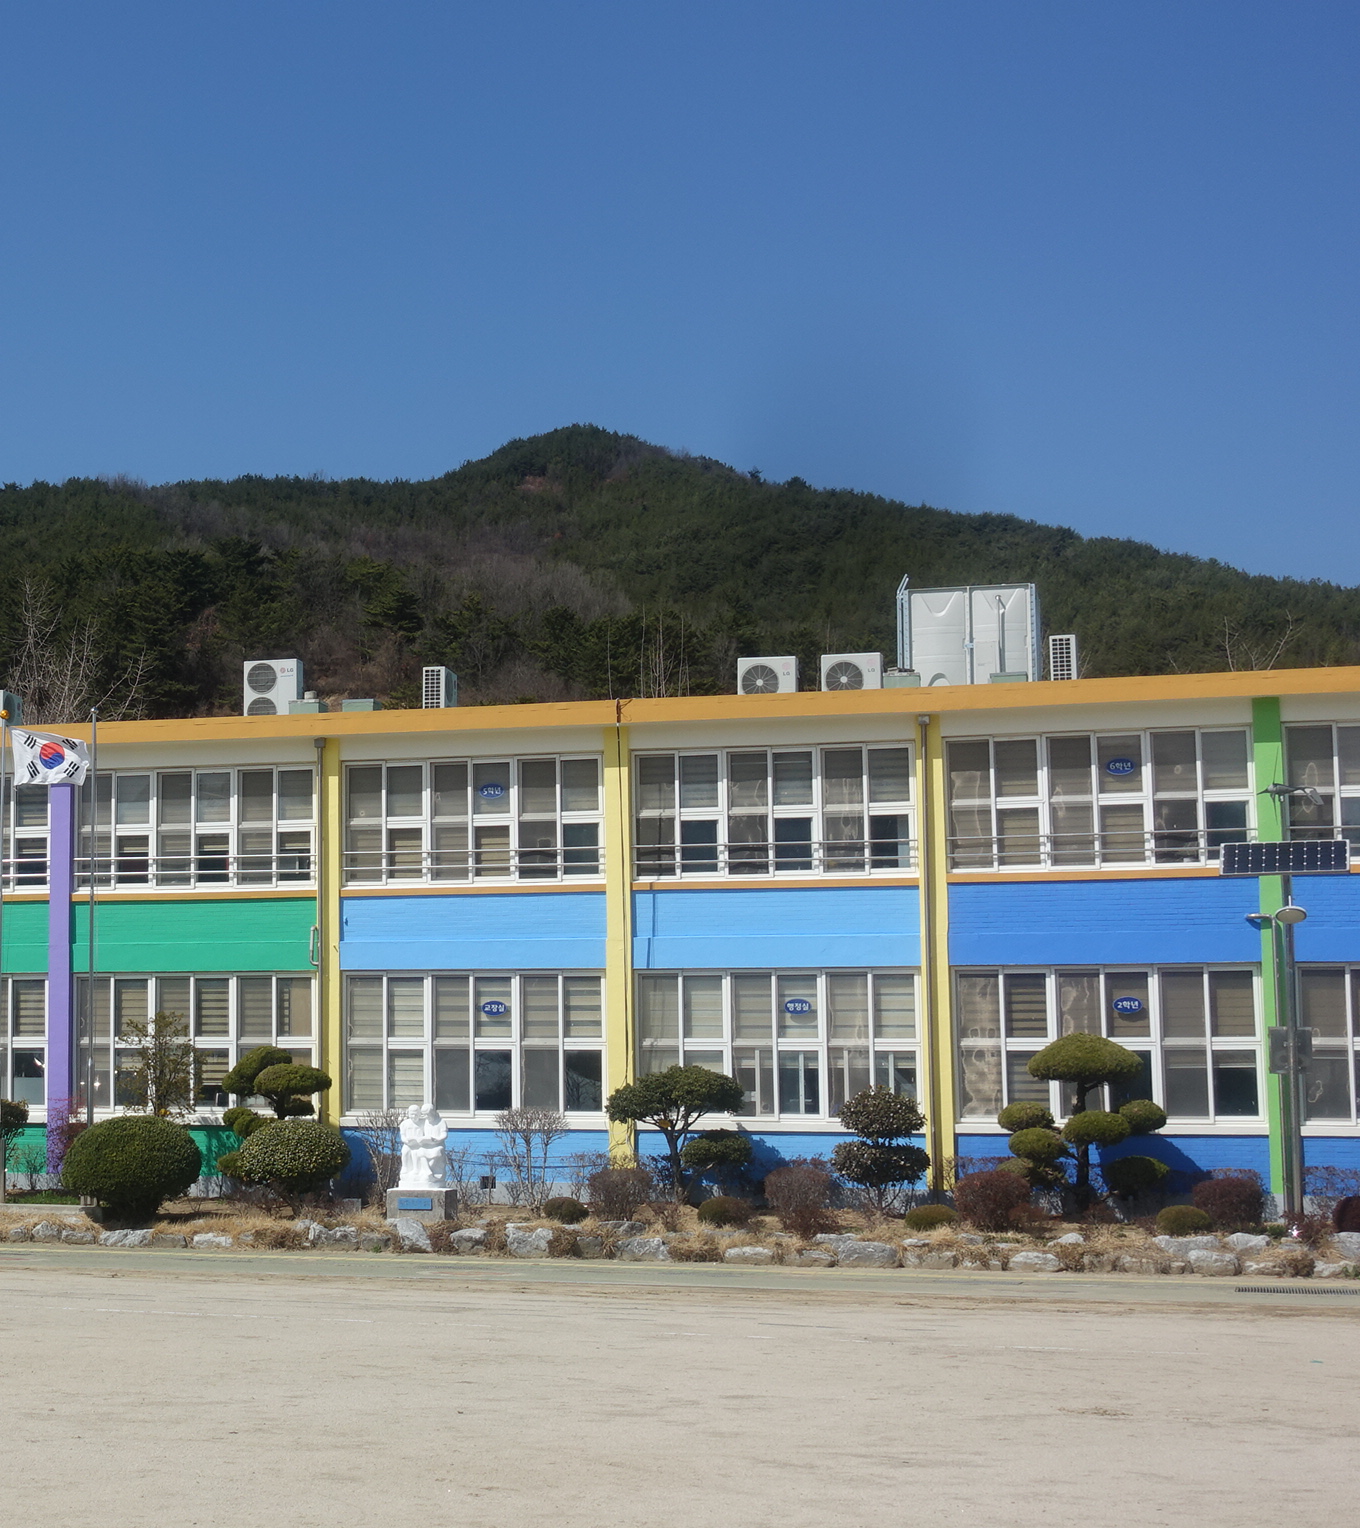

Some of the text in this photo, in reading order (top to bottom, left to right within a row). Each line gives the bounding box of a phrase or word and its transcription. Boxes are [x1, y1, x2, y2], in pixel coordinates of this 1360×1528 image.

[1109, 762, 1131, 771] 6학년
[483, 786, 501, 795] 5학년
[484, 1004, 505, 1013] 교장실
[786, 1003, 809, 1011] 행정실
[1117, 1001, 1139, 1010] 2학년
